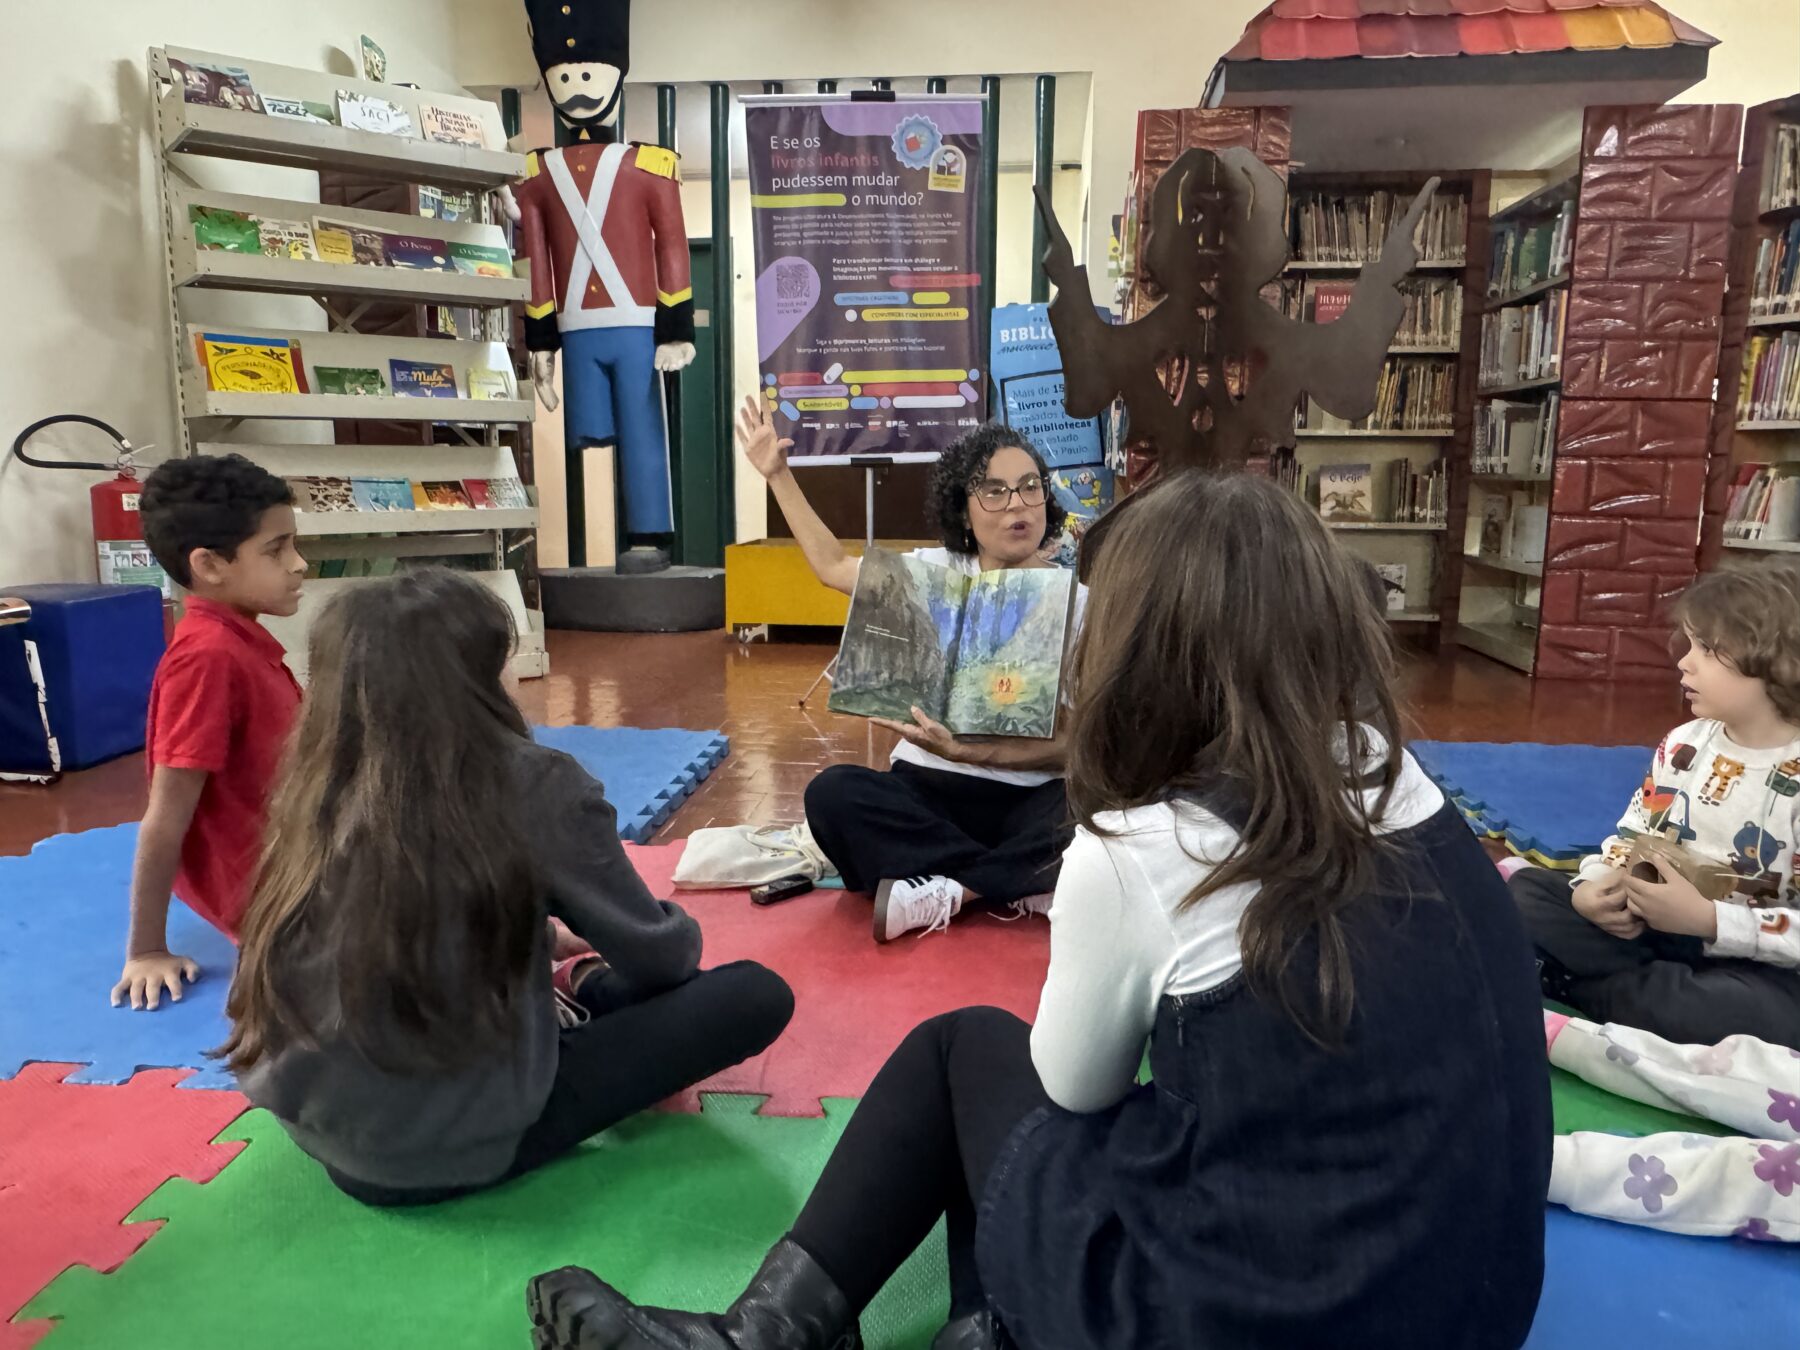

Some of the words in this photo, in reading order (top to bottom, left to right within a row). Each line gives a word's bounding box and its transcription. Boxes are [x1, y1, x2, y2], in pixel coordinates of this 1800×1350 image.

[770, 135, 779, 149] E
[783, 137, 799, 149] se
[803, 136, 821, 148] os
[771, 153, 815, 169] livros
[819, 152, 879, 167] infantis
[772, 173, 848, 192] pudessem
[852, 171, 900, 187] mudar
[851, 194, 861, 206] o
[865, 191, 924, 206] mundo?
[1038, 385, 1050, 397] de
[1018, 400, 1048, 411] livros
[1033, 420, 1092, 434] bibliotecas
